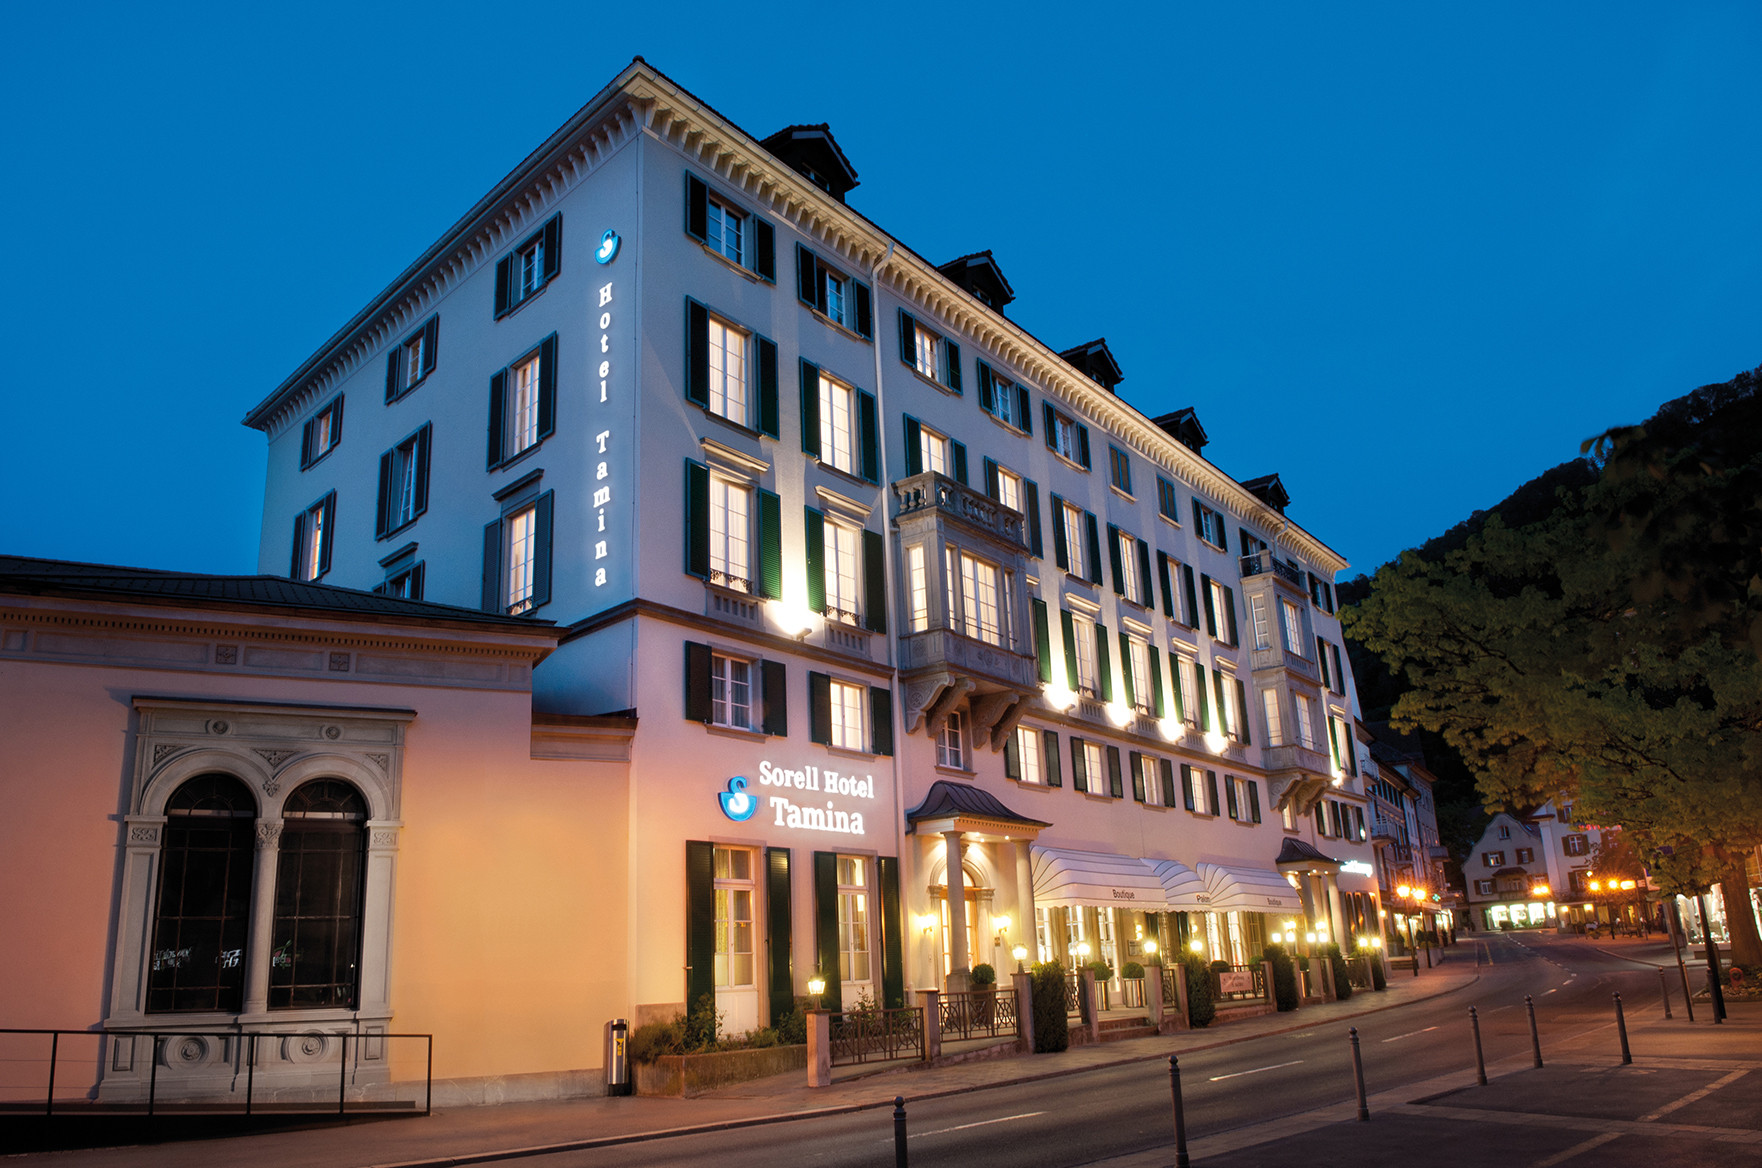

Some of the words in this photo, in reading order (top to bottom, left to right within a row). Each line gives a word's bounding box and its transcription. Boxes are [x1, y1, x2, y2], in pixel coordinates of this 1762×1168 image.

[598, 282, 613, 403] Hotel
[593, 430, 611, 587] Tamina
[759, 760, 819, 791] Sorell
[823, 771, 875, 799] Hotel
[769, 796, 865, 835] Tamina
[1112, 889, 1135, 901] Boutique
